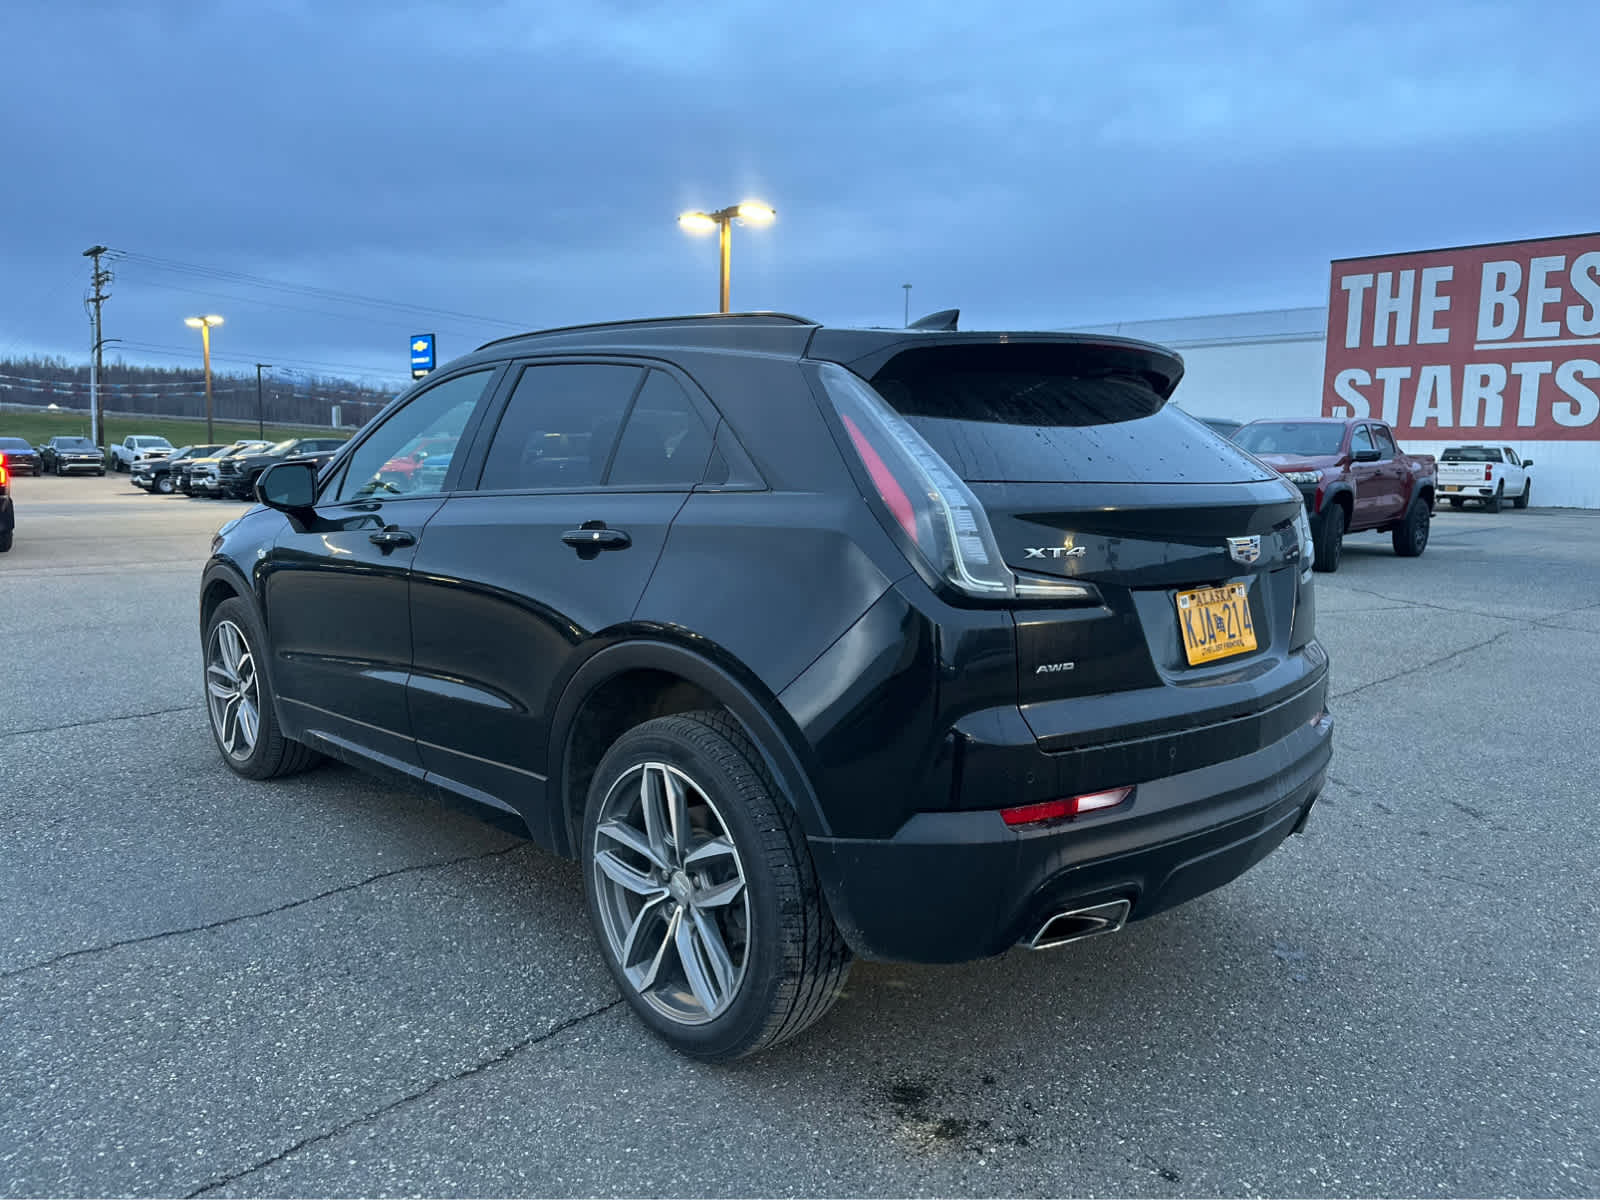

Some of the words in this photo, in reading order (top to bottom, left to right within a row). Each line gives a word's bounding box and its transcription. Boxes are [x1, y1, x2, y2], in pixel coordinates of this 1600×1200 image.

[1341, 265, 1454, 348] THE
[1476, 251, 1600, 342] BES
[1331, 359, 1600, 428] STARTS
[1024, 546, 1086, 559] XT4
[1196, 588, 1233, 607] ALASKA
[1183, 607, 1217, 648] KJA
[1222, 599, 1252, 640] 214
[1036, 662, 1074, 674] AWD
